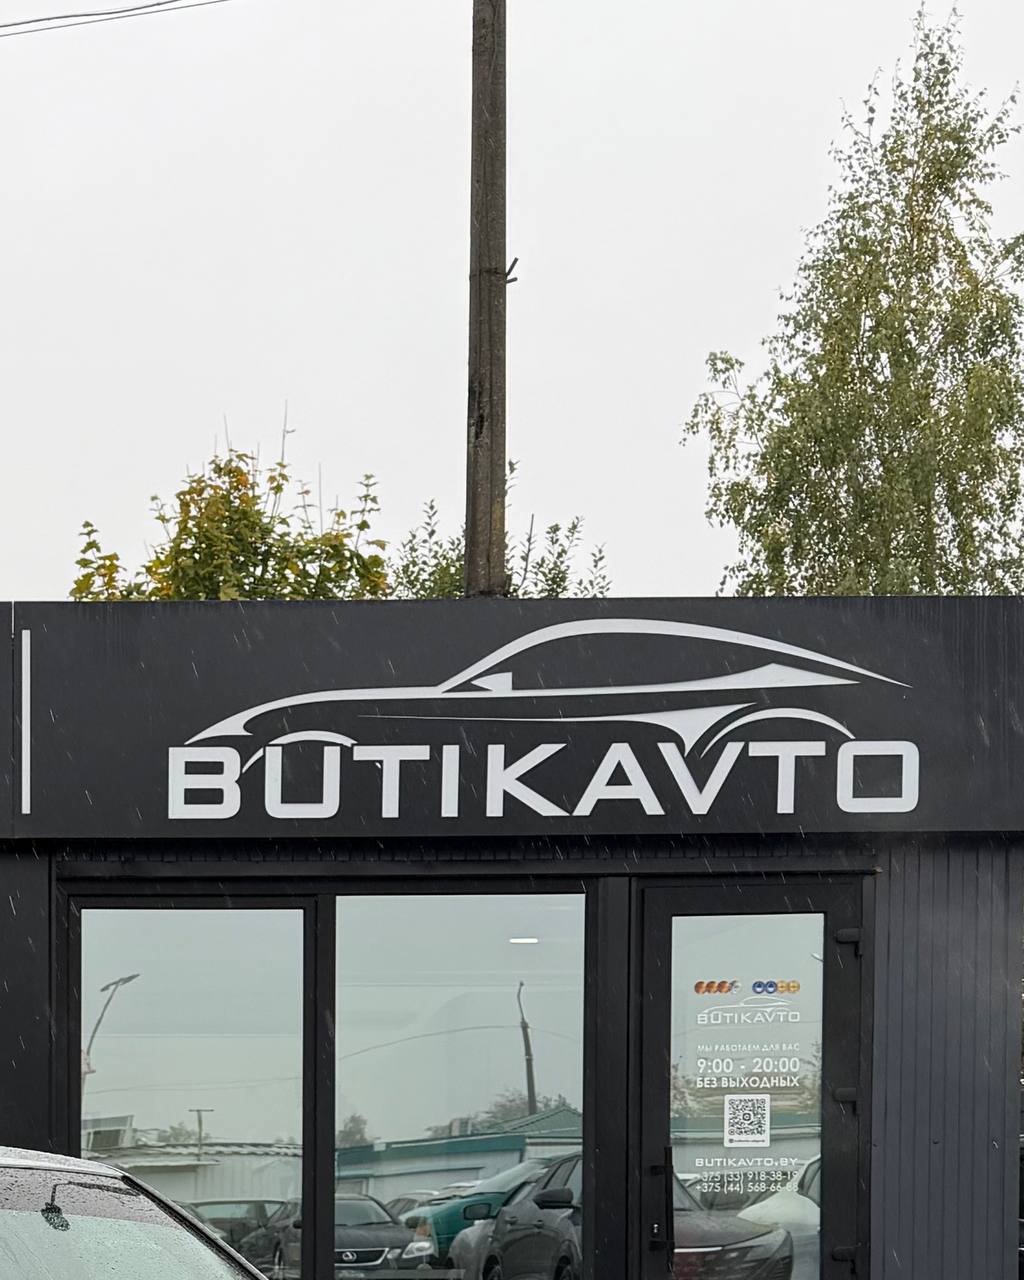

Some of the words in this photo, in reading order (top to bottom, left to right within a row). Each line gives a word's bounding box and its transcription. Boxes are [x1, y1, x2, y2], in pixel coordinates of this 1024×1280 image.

[167, 739, 921, 819] BUTIKAVTO
[697, 1011, 800, 1024] BUTIKAVTO
[697, 1058, 733, 1073] 9:00
[752, 1057, 800, 1073] 20:00
[696, 1077, 717, 1089] БЕЗ
[721, 1076, 800, 1089] ВЫХОДНЫХ
[695, 1157, 798, 1167] BUTIKAVTO.BY
[696, 1183, 721, 1193] +375
[724, 1181, 744, 1195] (44)
